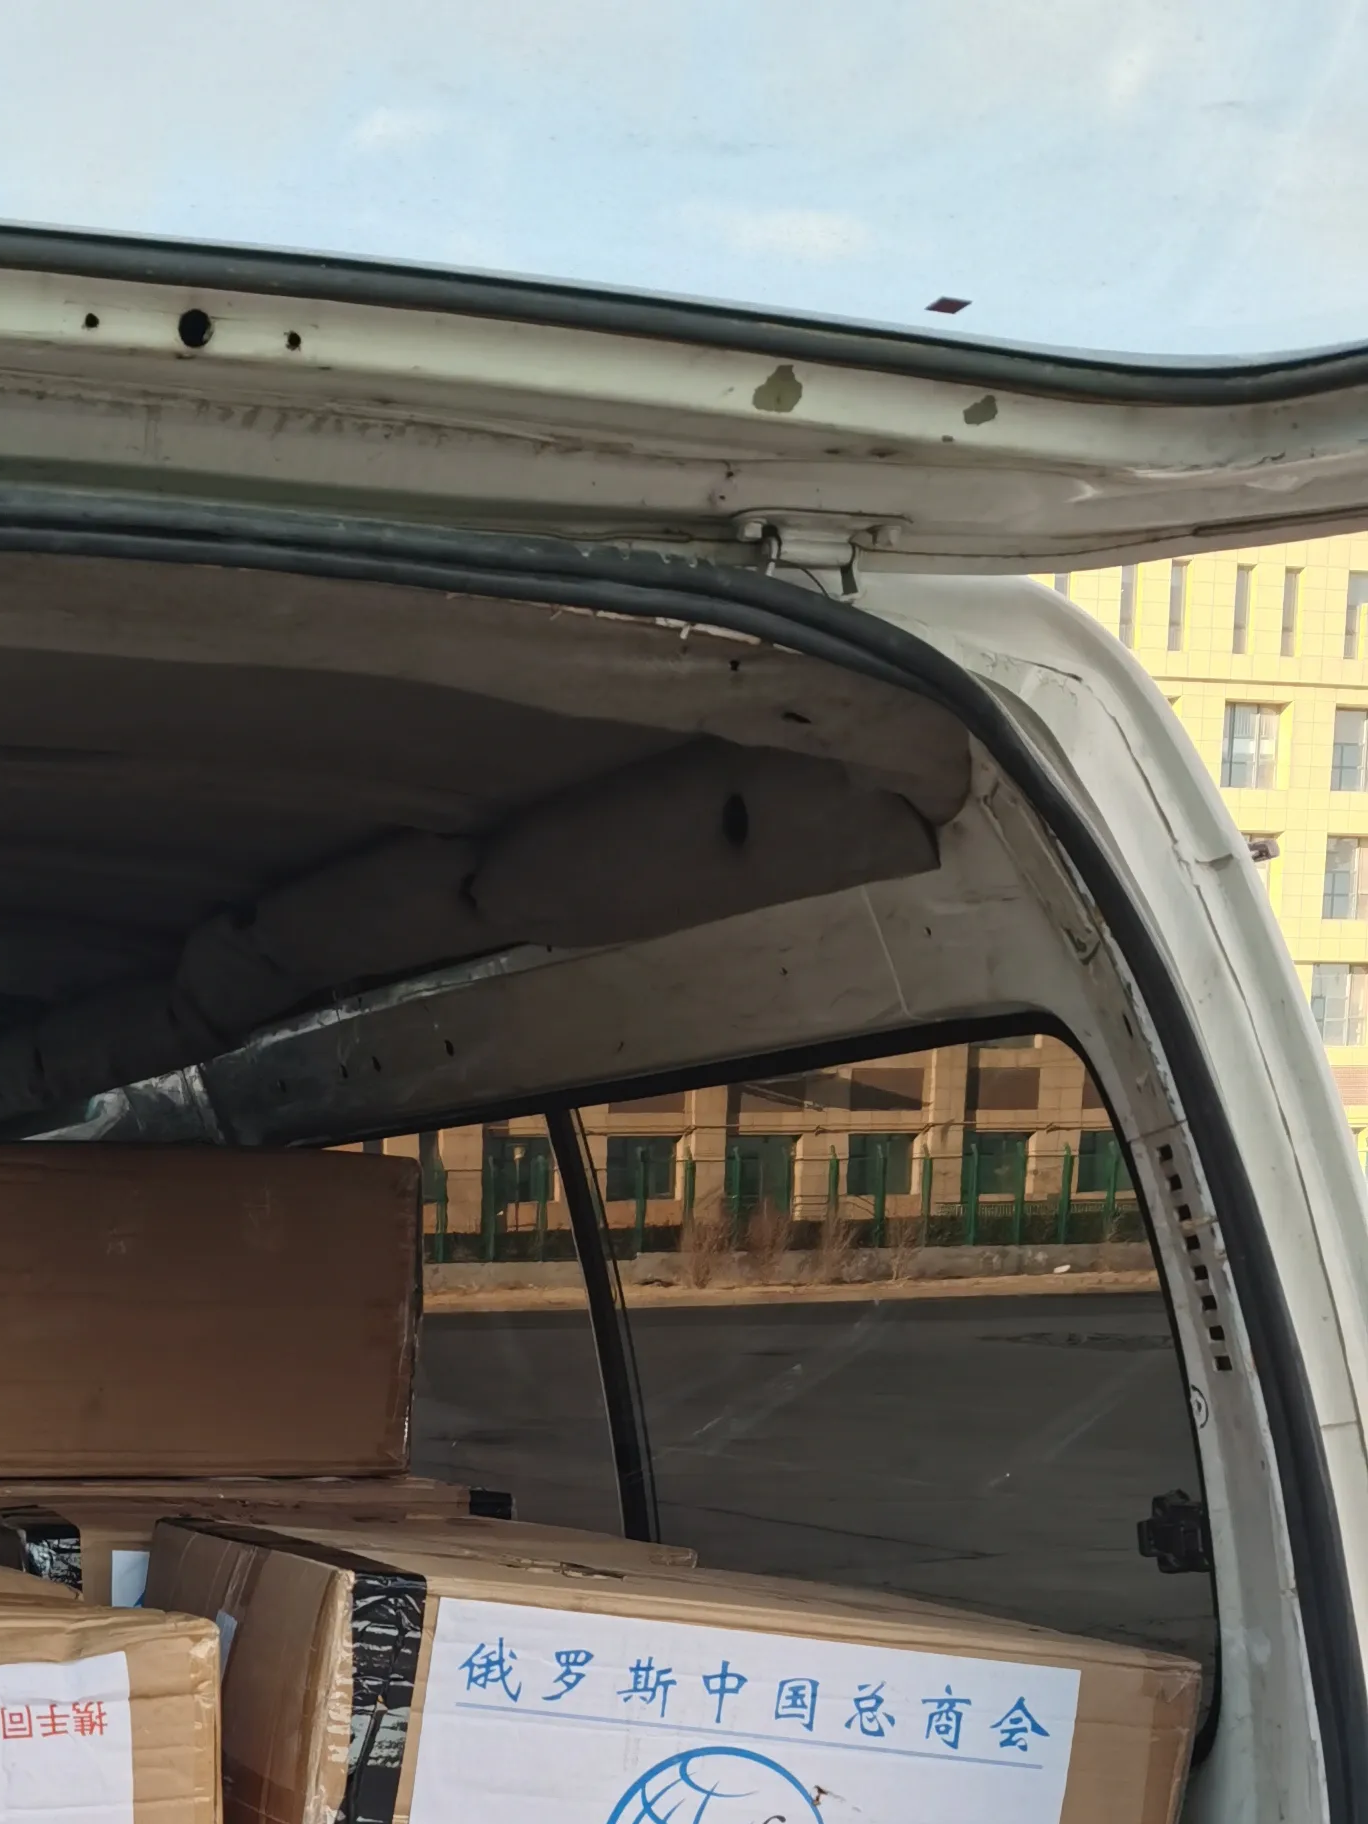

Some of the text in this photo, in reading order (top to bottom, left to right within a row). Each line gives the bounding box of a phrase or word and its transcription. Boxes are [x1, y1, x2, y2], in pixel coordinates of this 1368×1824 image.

[458, 1636, 1050, 1753] 俄罗斯中国总商会
